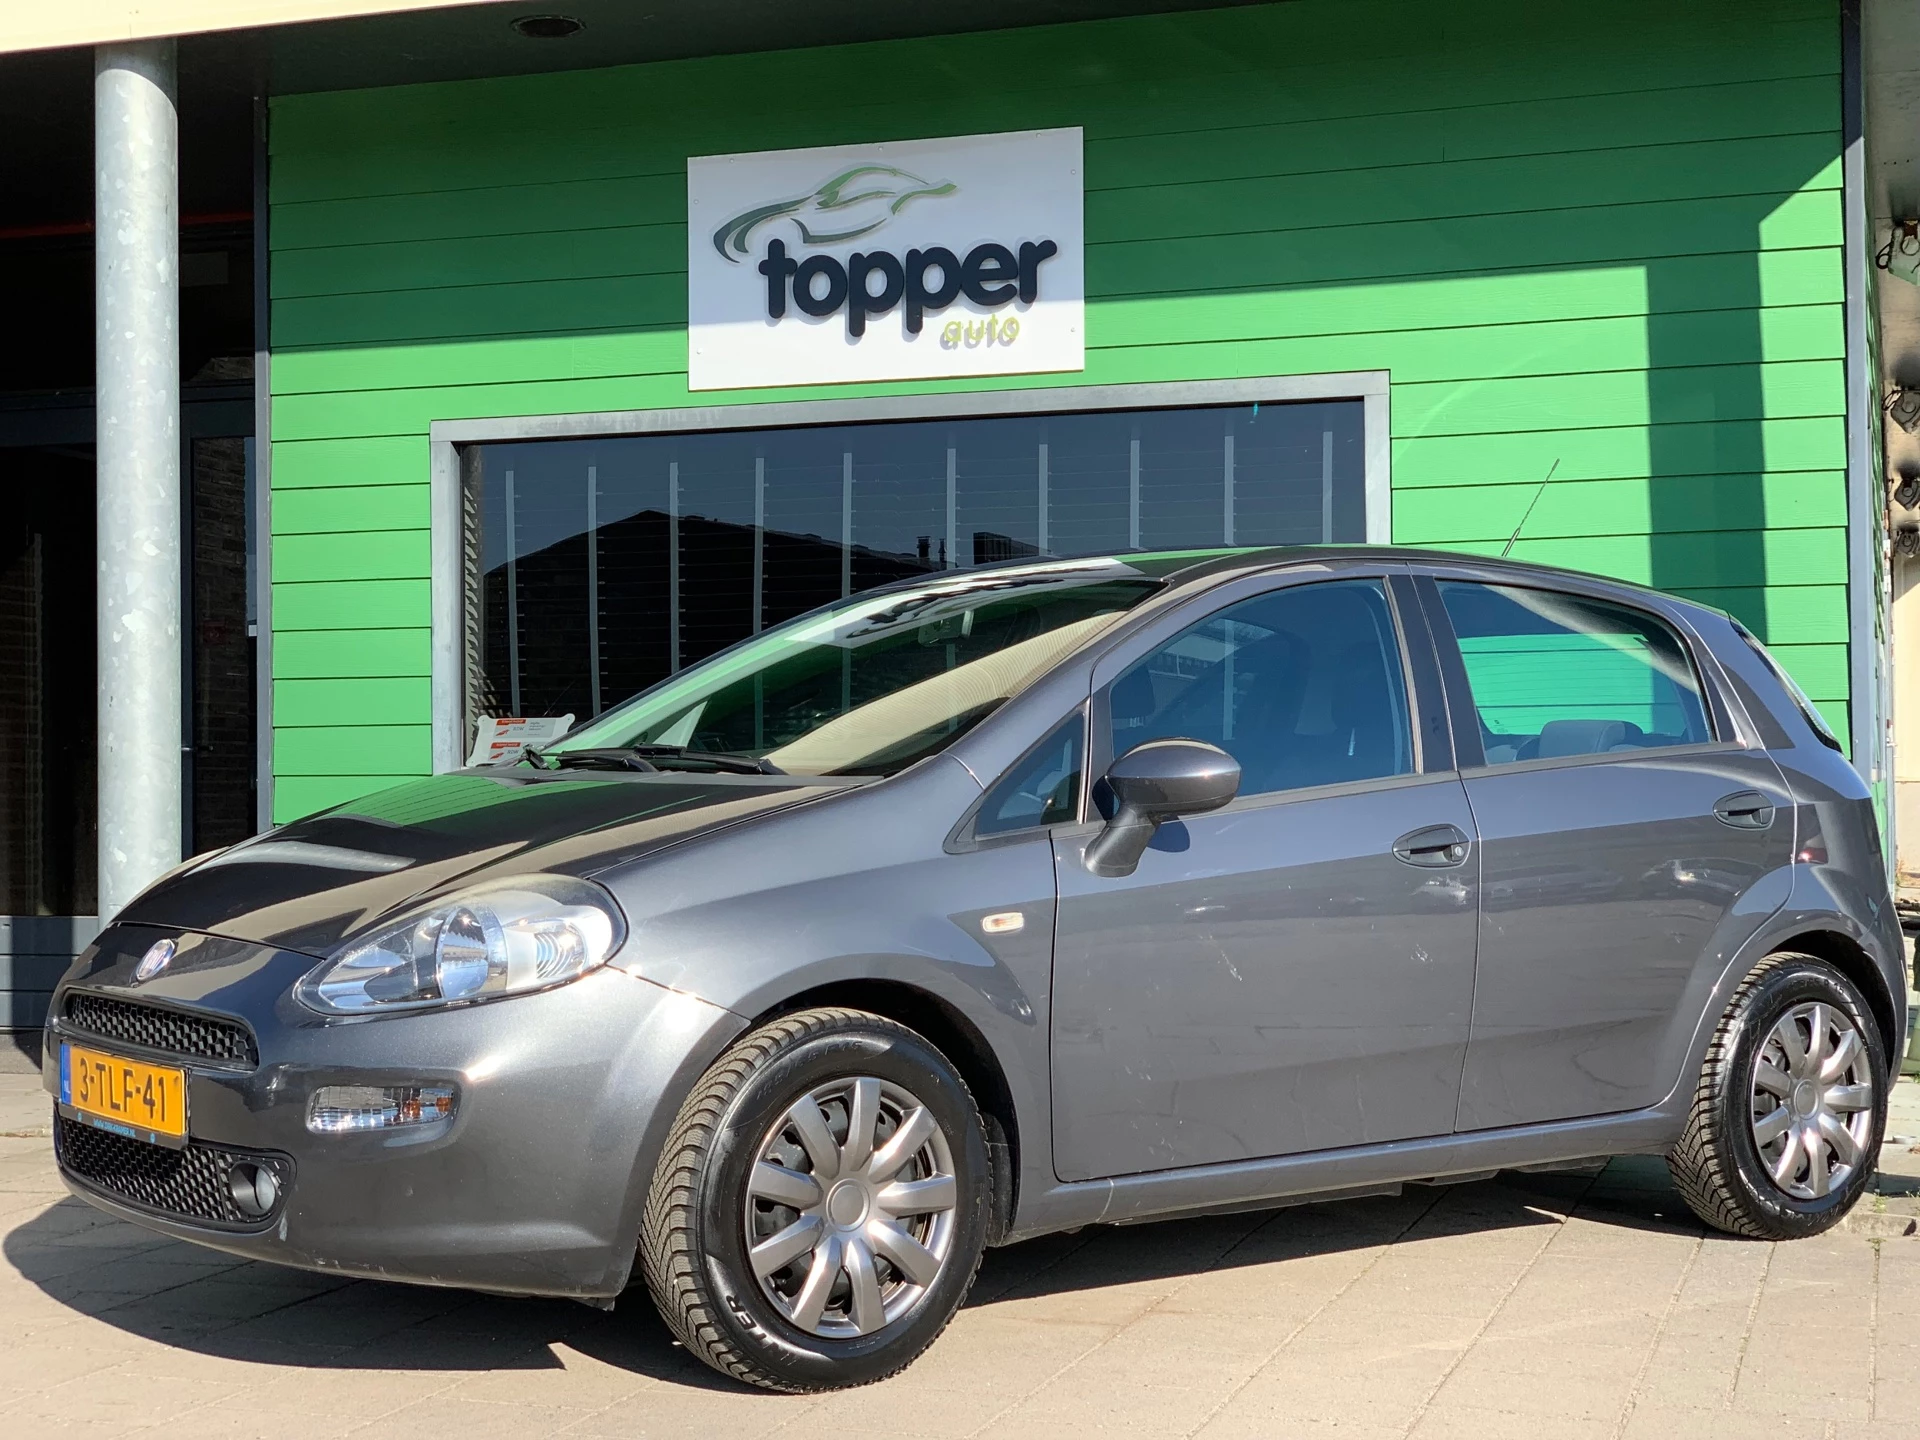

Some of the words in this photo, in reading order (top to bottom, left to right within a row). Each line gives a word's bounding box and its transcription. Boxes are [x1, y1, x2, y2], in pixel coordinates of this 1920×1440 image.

[759, 238, 1057, 337] topper
[944, 313, 1020, 343] auto
[80, 1056, 166, 1122] 3-TLF-41
